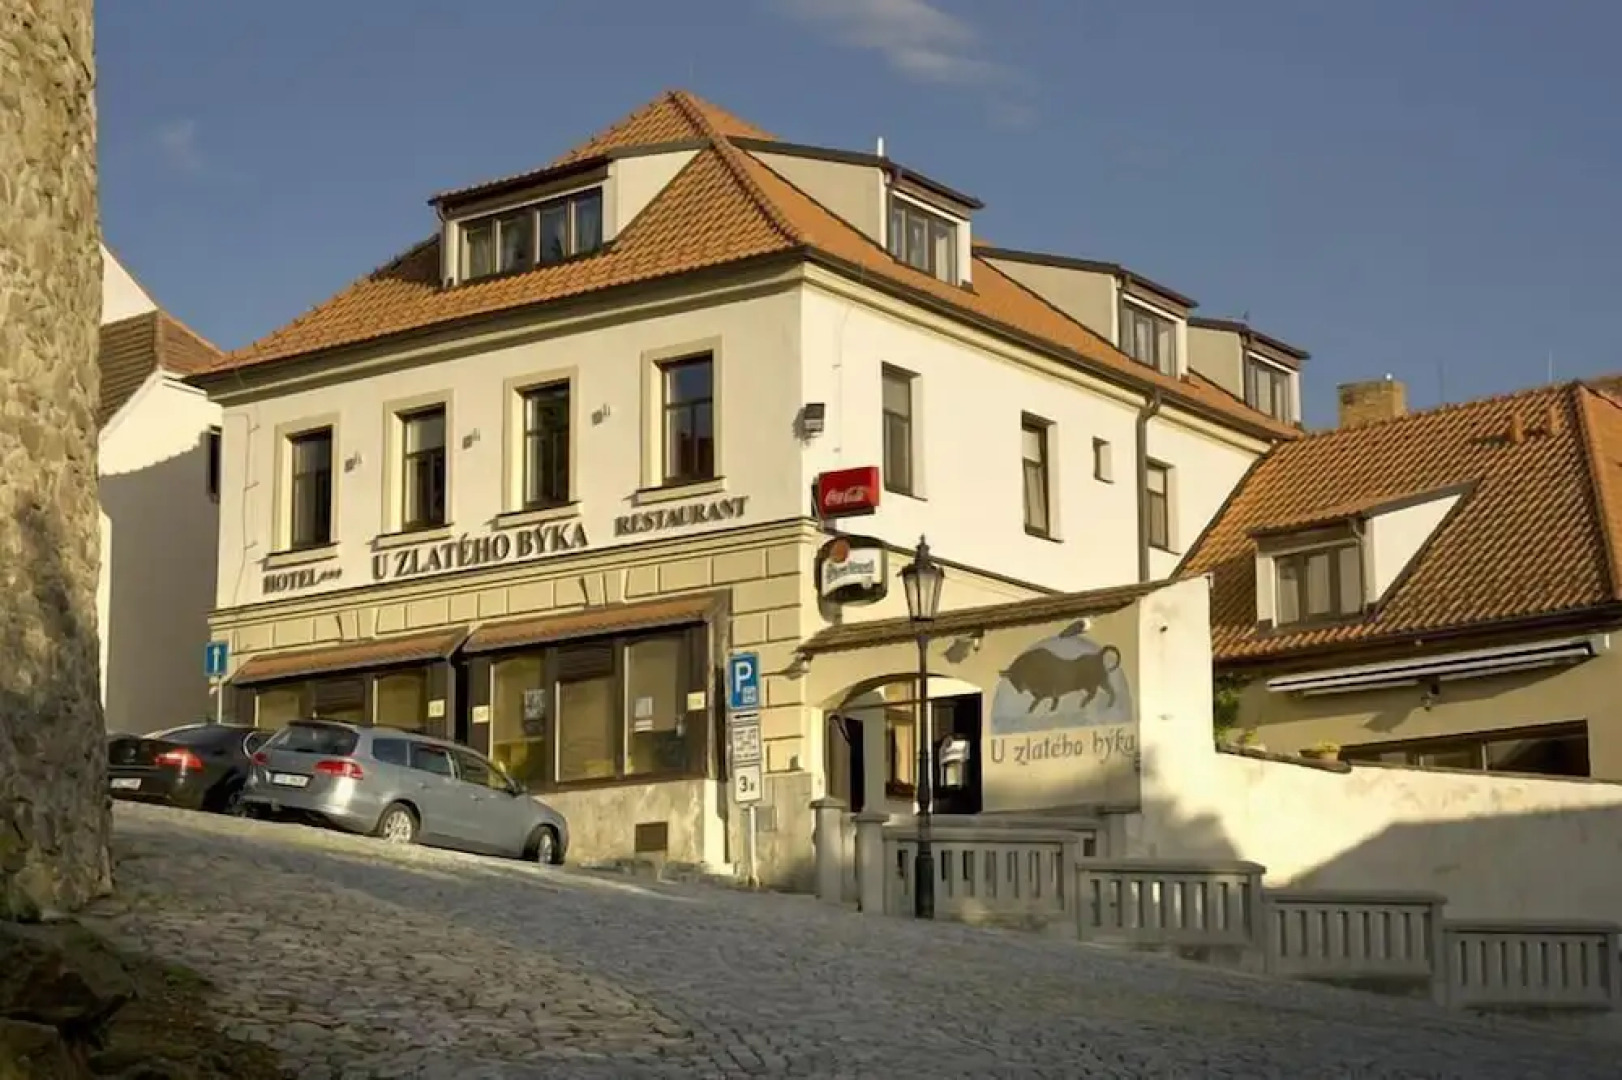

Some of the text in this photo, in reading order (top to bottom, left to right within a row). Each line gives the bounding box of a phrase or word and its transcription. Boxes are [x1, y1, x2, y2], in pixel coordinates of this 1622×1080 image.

[372, 555, 388, 579] U
[395, 532, 510, 577] ZLATÉHO
[516, 521, 589, 558] BÝKA
[614, 496, 748, 537] RESTAURANT
[735, 661, 752, 693] P
[991, 738, 1005, 764] U
